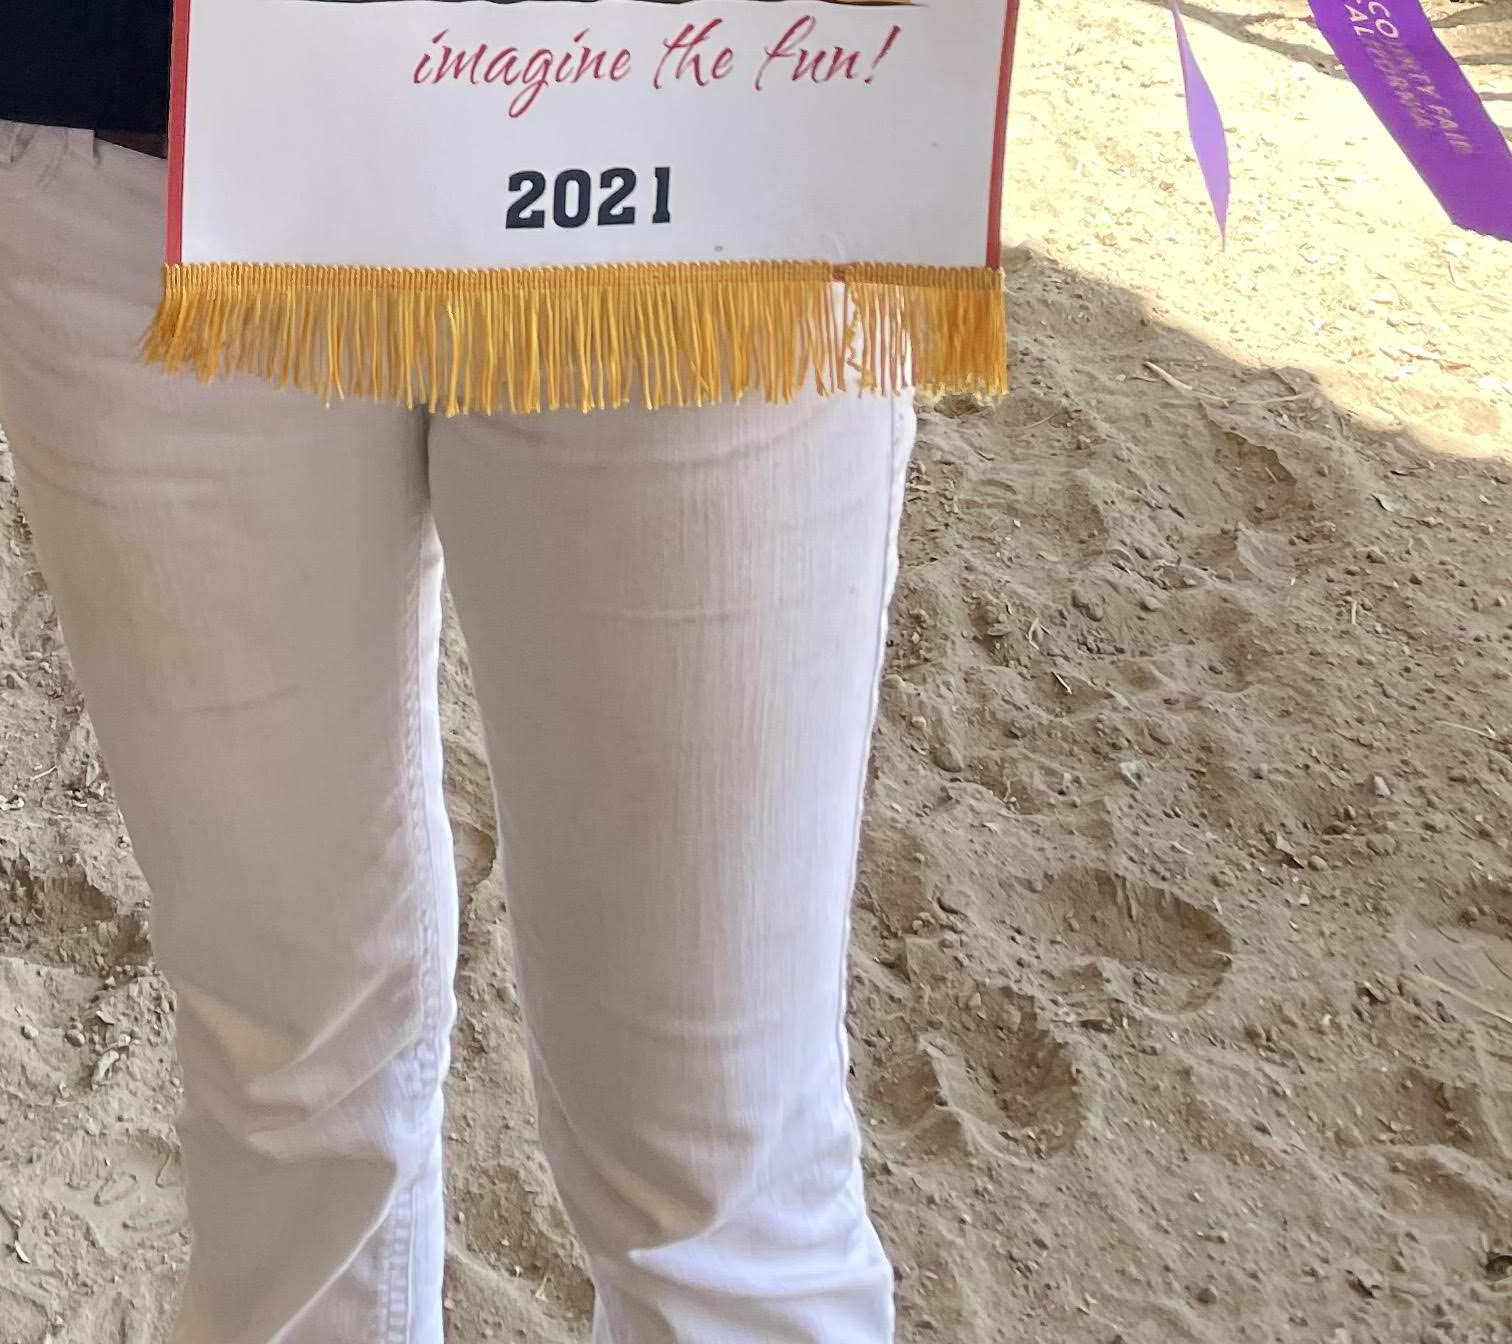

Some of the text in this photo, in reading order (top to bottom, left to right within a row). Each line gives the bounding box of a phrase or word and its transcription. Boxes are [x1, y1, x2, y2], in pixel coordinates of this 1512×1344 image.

[413, 15, 901, 118] imagine the fun!
[505, 166, 671, 230] 2021
